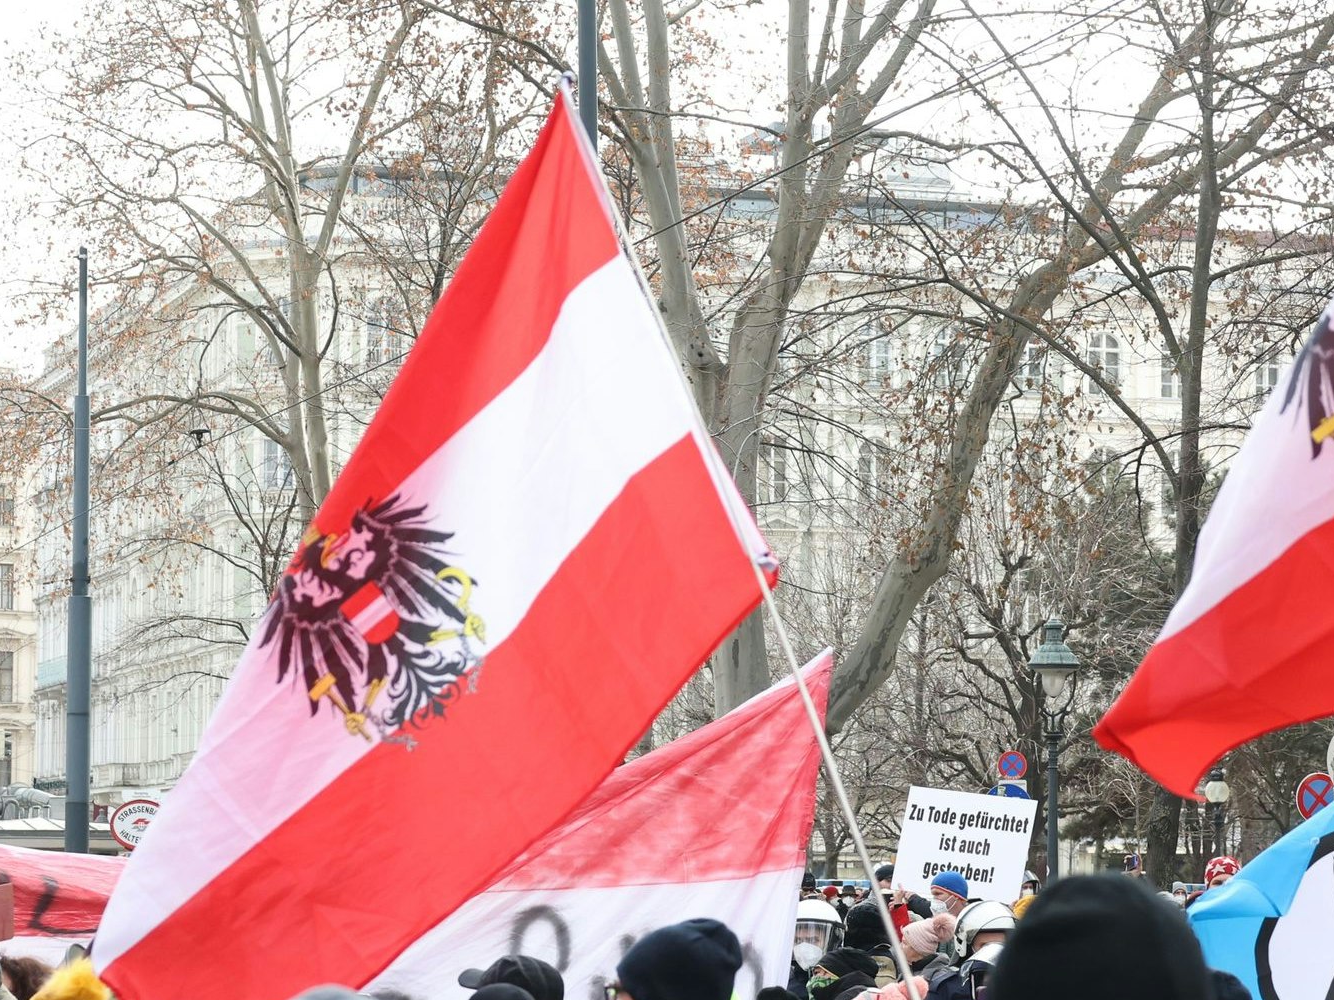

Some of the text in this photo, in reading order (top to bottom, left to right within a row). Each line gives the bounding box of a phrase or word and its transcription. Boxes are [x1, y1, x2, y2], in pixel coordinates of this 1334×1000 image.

[909, 804, 1028, 834] Zu Tode gefürchtet
[120, 829, 141, 844] HALTE
[939, 834, 991, 856] ist auch
[922, 862, 995, 883] gestorben!
